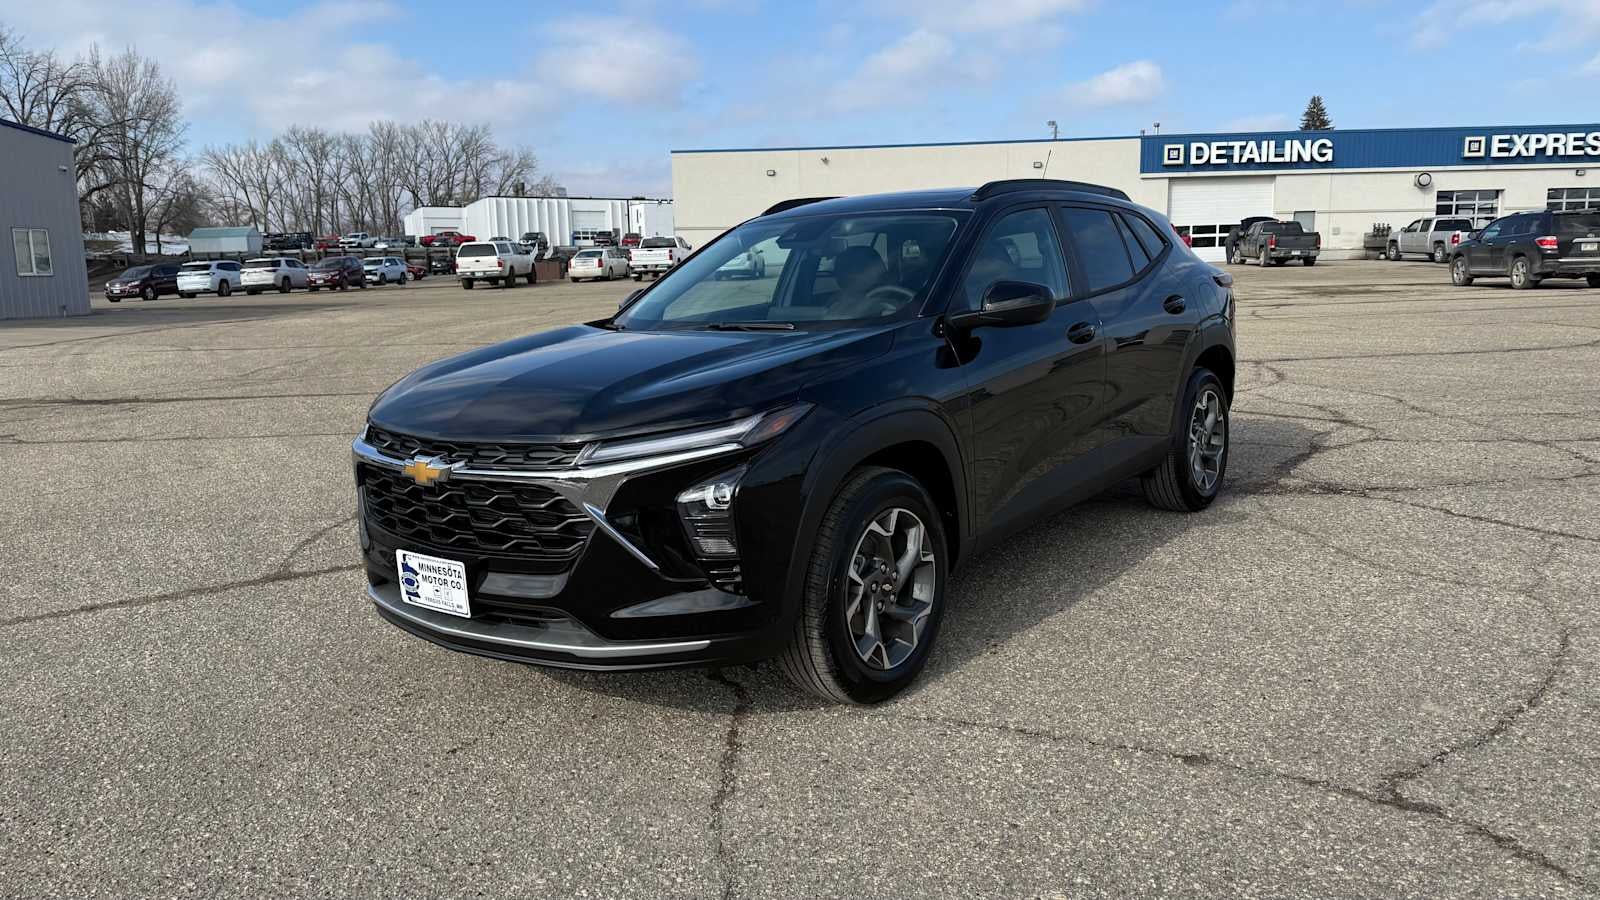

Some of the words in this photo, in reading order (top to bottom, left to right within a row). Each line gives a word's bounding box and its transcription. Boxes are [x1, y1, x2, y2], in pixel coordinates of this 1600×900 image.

[1190, 139, 1333, 164] DETAILING
[1490, 132, 1600, 157] EXPRES
[418, 562, 462, 579] MINNESOTA
[421, 574, 449, 587] MOTOR
[450, 580, 464, 590] CO.
